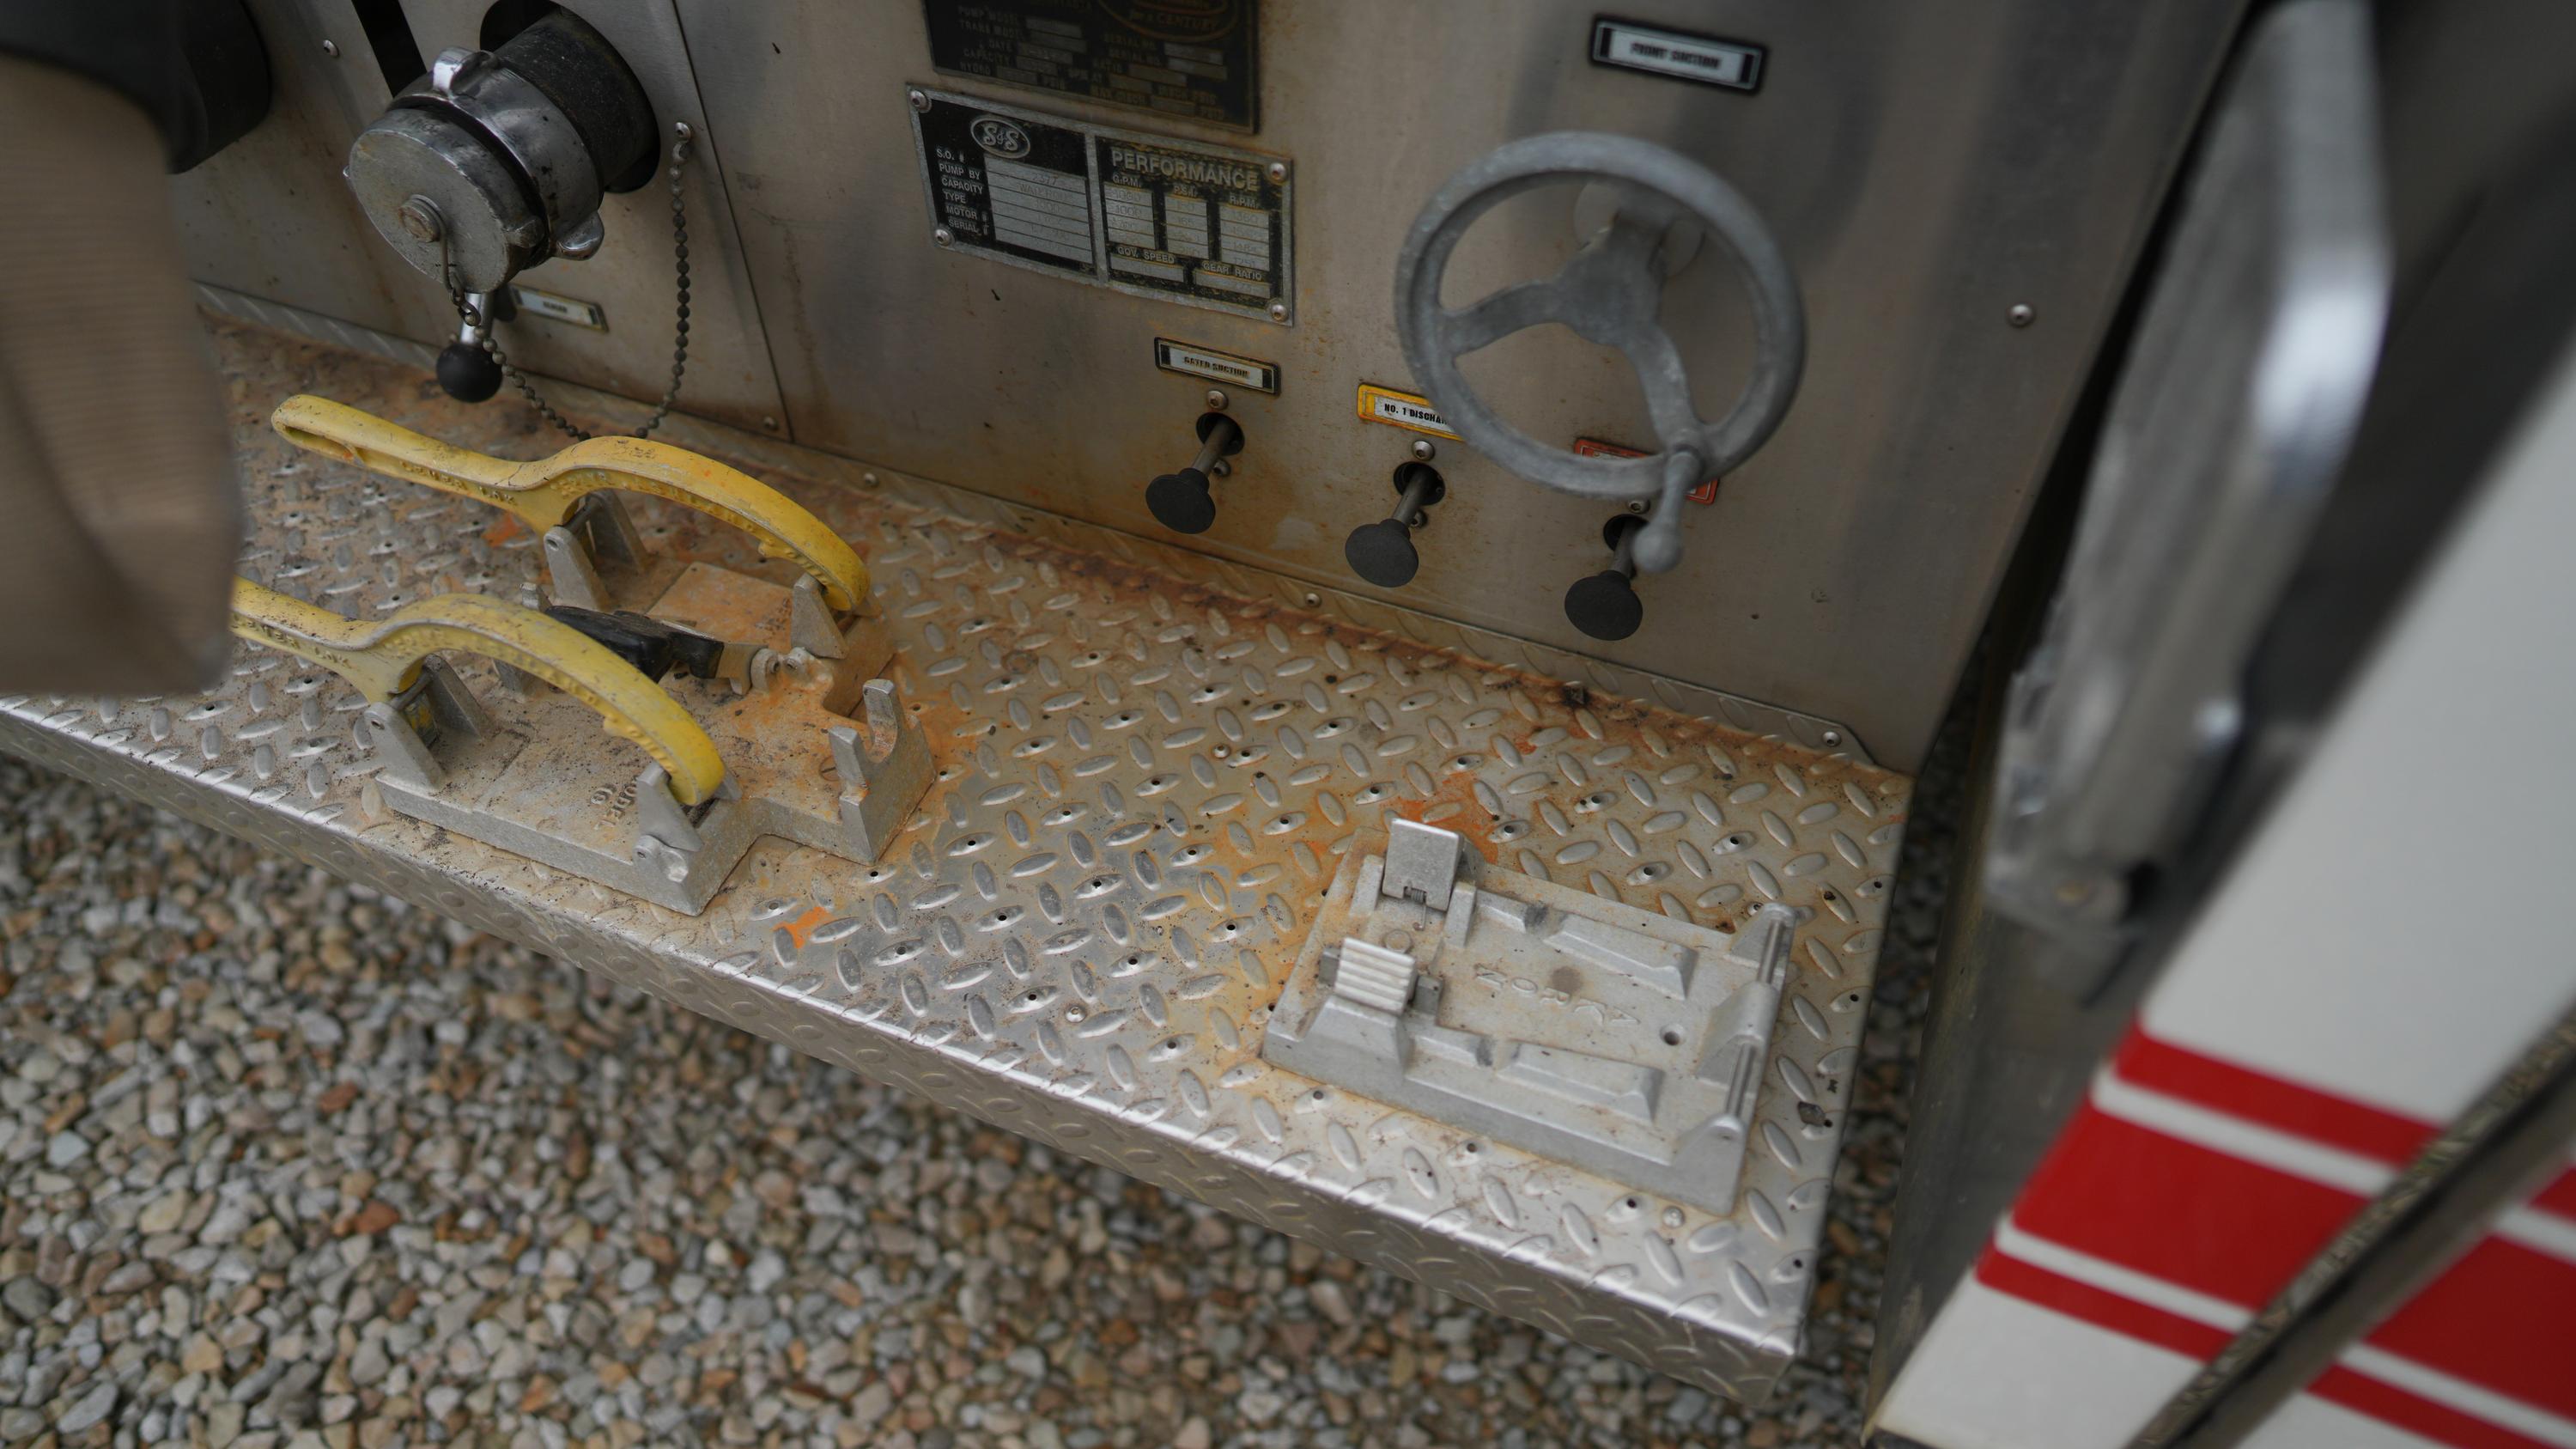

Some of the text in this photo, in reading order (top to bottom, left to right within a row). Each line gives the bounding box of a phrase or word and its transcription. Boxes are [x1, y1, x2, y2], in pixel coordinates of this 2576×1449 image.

[1157, 13, 1219, 30] CENTURY
[963, 48, 1012, 65] CAPACITY
[1631, 42, 1721, 69] FRONT SUCTION
[981, 123, 1019, 152] S&S
[936, 147, 955, 161] S.O.
[939, 163, 981, 180] PUMP BY
[1110, 149, 1260, 192] PERFORMANCE
[941, 177, 983, 195] CAPACITY
[1112, 173, 1141, 187] G.P.M.
[944, 191, 966, 204] TYPE
[1230, 195, 1260, 210] R.P.M.
[945, 205, 977, 220] MOTOR
[948, 218, 979, 234] SERIAL
[1117, 246, 1139, 259] GOV.
[1143, 250, 1175, 265] SPEED
[1203, 260, 1263, 282] GEAR RATIO
[1183, 356, 1249, 379] GATED SUCTION
[1384, 403, 1399, 414] NO.
[1402, 407, 1407, 416] 1
[592, 776, 637, 831] ODEL
